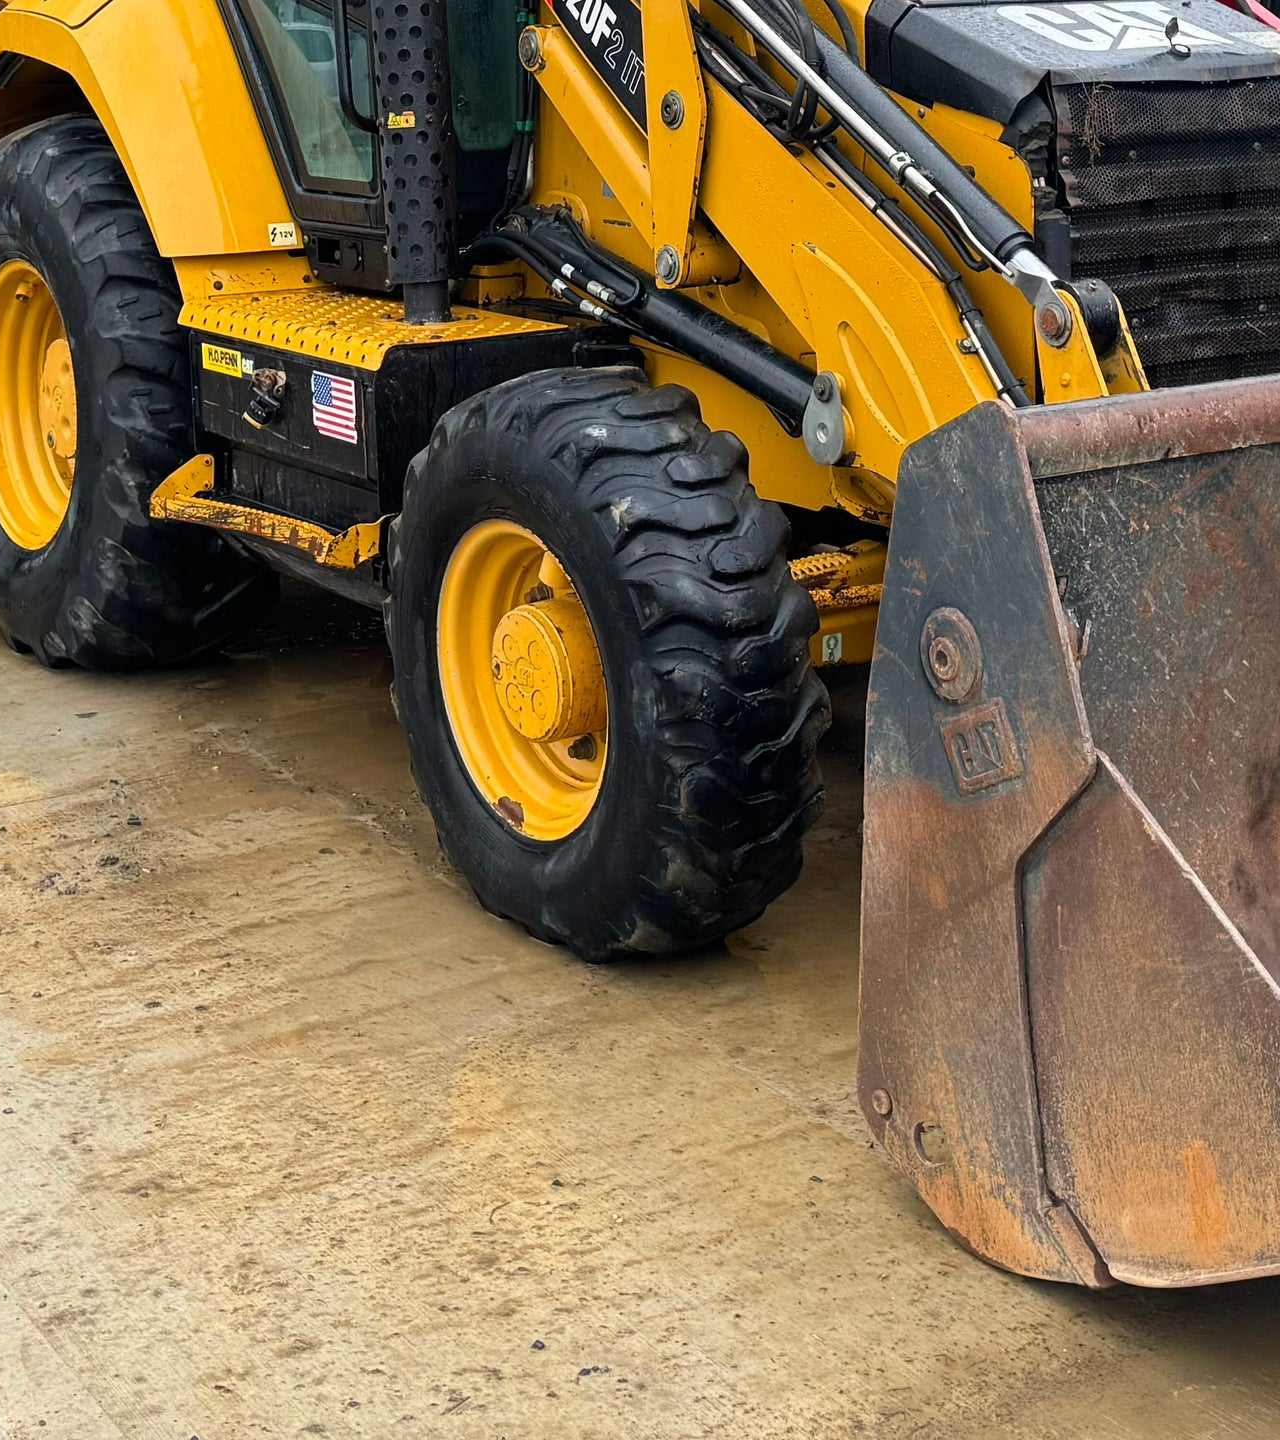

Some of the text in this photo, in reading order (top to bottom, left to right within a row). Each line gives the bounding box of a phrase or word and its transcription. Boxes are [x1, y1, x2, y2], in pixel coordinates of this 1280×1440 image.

[996, 1, 1235, 52] CAT
[279, 230, 294, 238] 12V
[951, 720, 1004, 781] CAT
